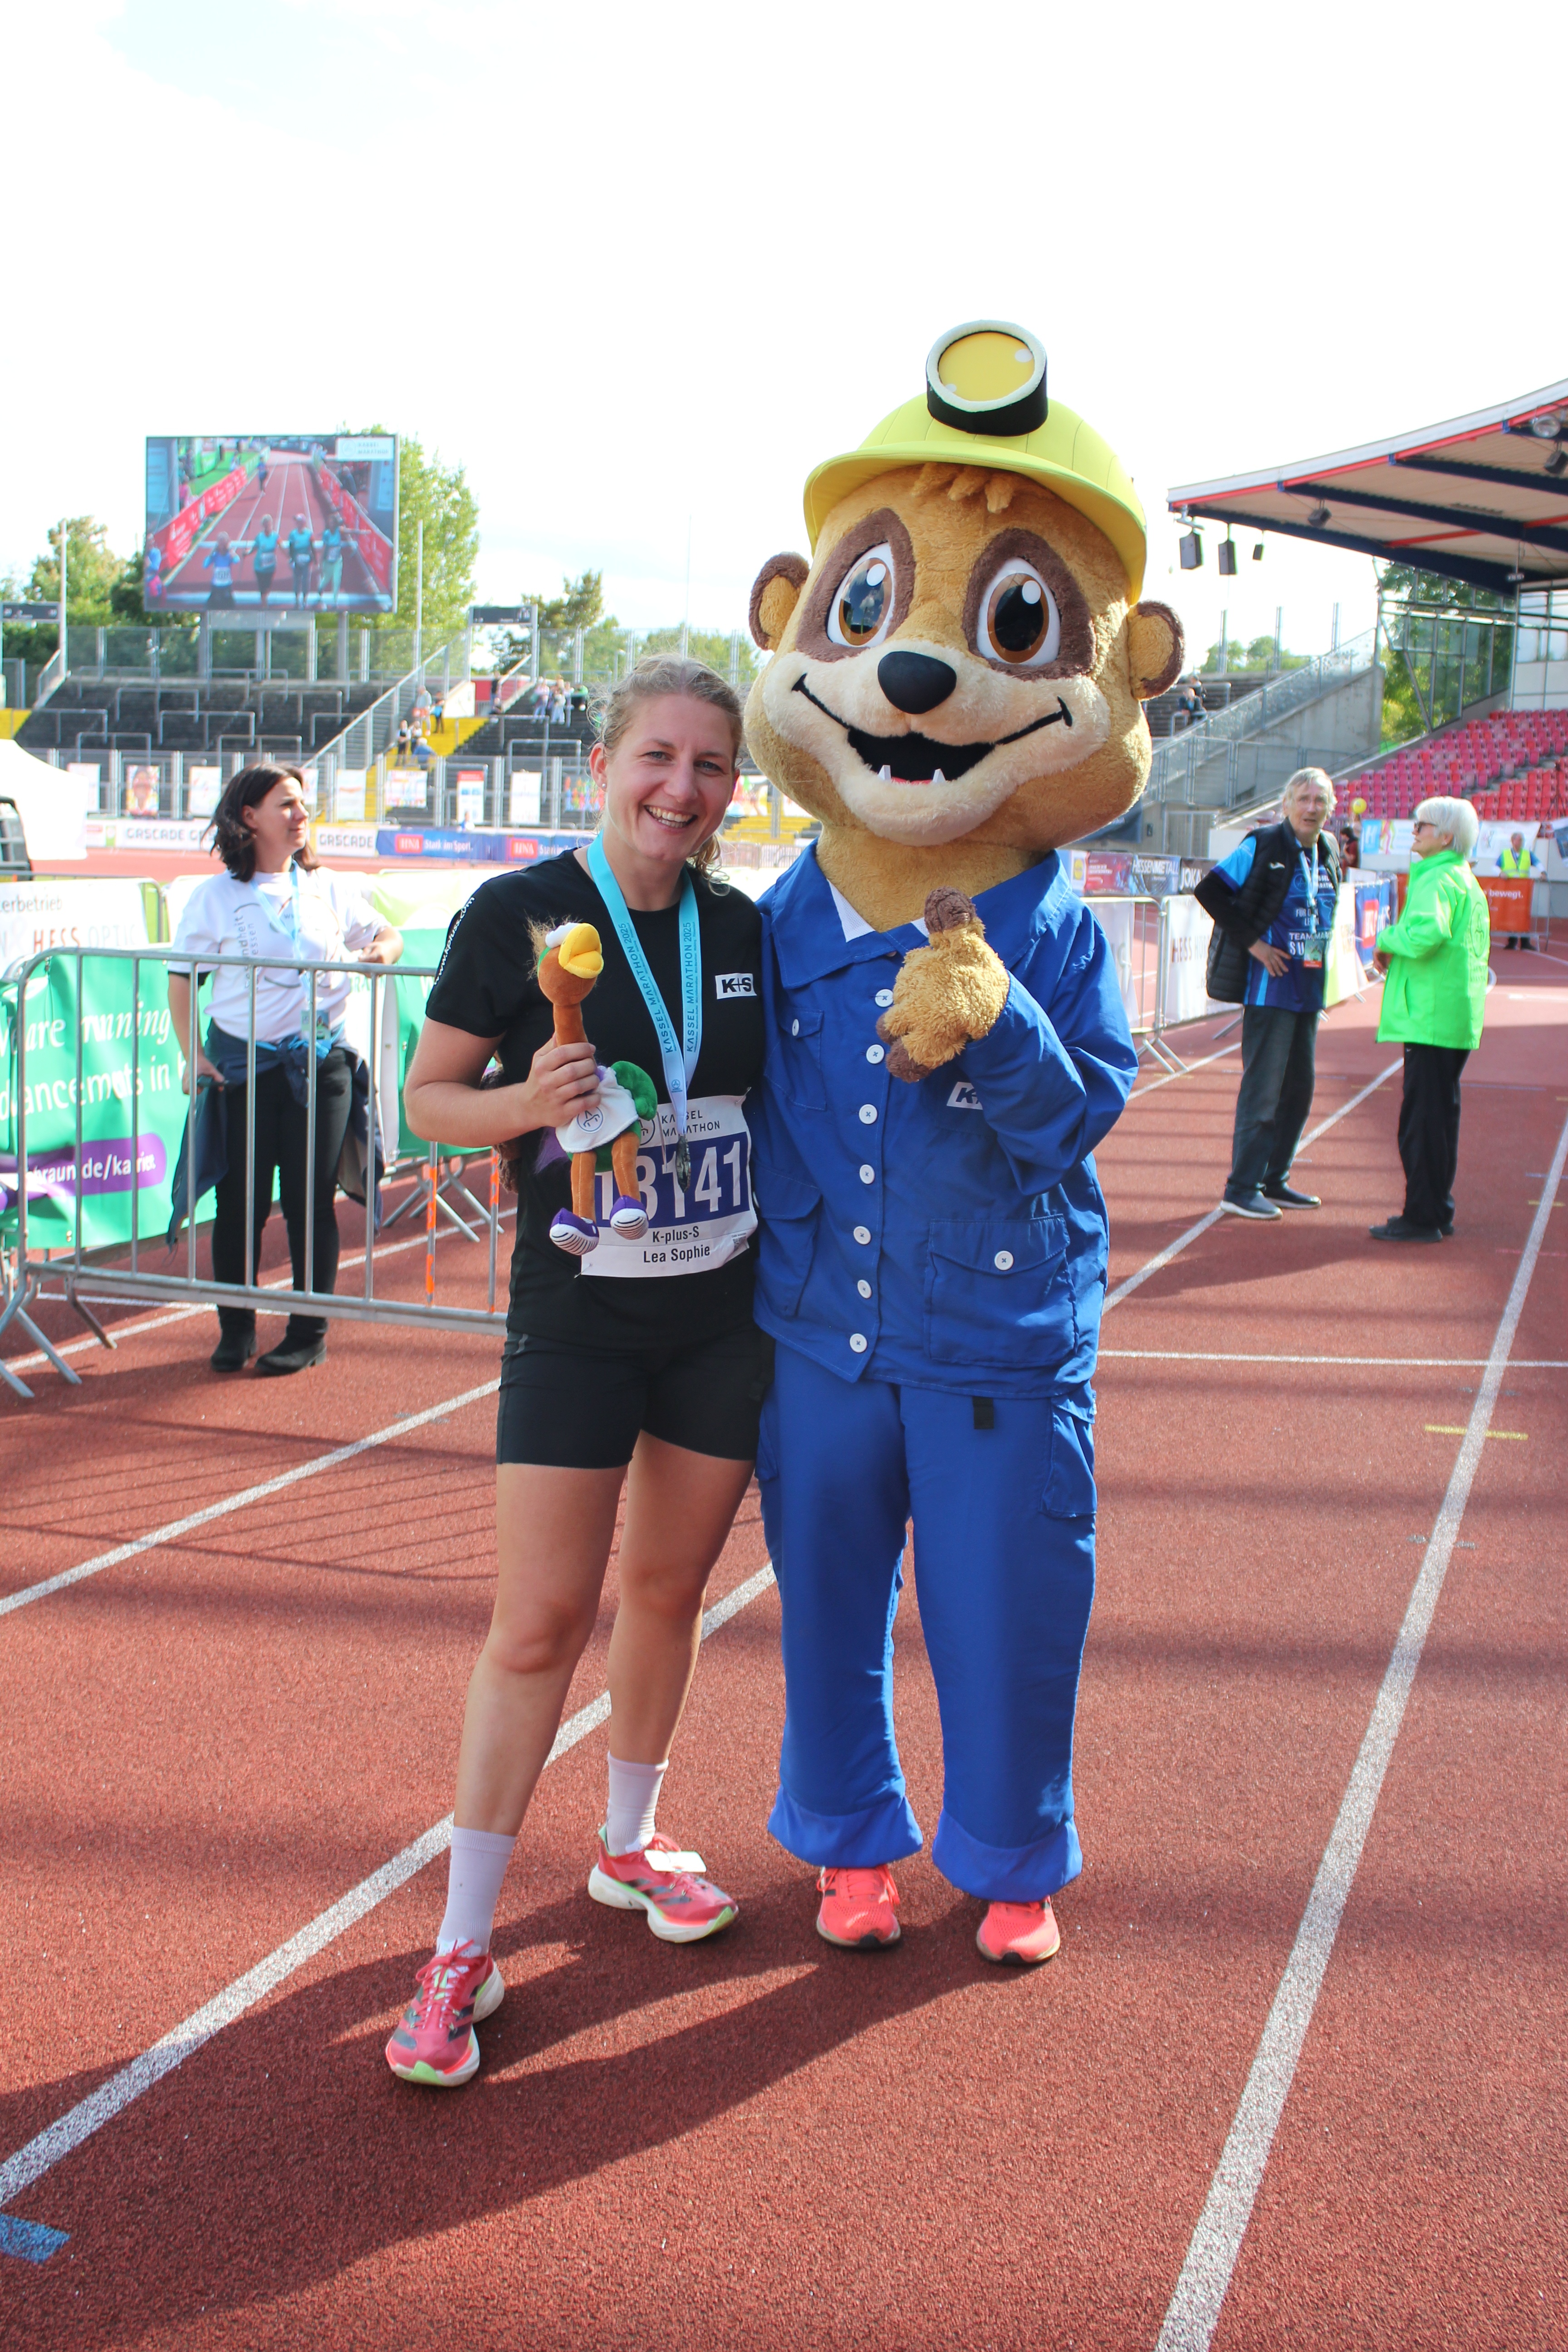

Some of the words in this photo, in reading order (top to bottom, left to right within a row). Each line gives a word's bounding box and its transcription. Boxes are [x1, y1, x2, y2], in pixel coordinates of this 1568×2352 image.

[126, 827, 185, 842] GASCADE
[319, 833, 373, 848] GASCADE
[1132, 859, 1180, 875] HESSENMETALL
[0, 894, 63, 913] erbetrieb
[1489, 889, 1524, 901] bewegt.
[618, 923, 632, 944] 2025
[683, 922, 692, 942] 2025
[1289, 932, 1313, 941] TEAM
[1171, 937, 1192, 963] HESS
[627, 946, 657, 1006] MARATHON
[684, 945, 695, 1004] MARATHON
[721, 977, 752, 994] K+S
[655, 1009, 673, 1054] KASSEL
[686, 1009, 695, 1052] KASSEL
[150, 1055, 170, 1092] in
[662, 1110, 703, 1124] KASEL
[663, 1120, 720, 1137] MAATHON
[595, 1141, 741, 1220] 13141
[652, 1225, 700, 1244] K-plus-S
[644, 1250, 666, 1263] Lea
[671, 1245, 710, 1262] Sophie
